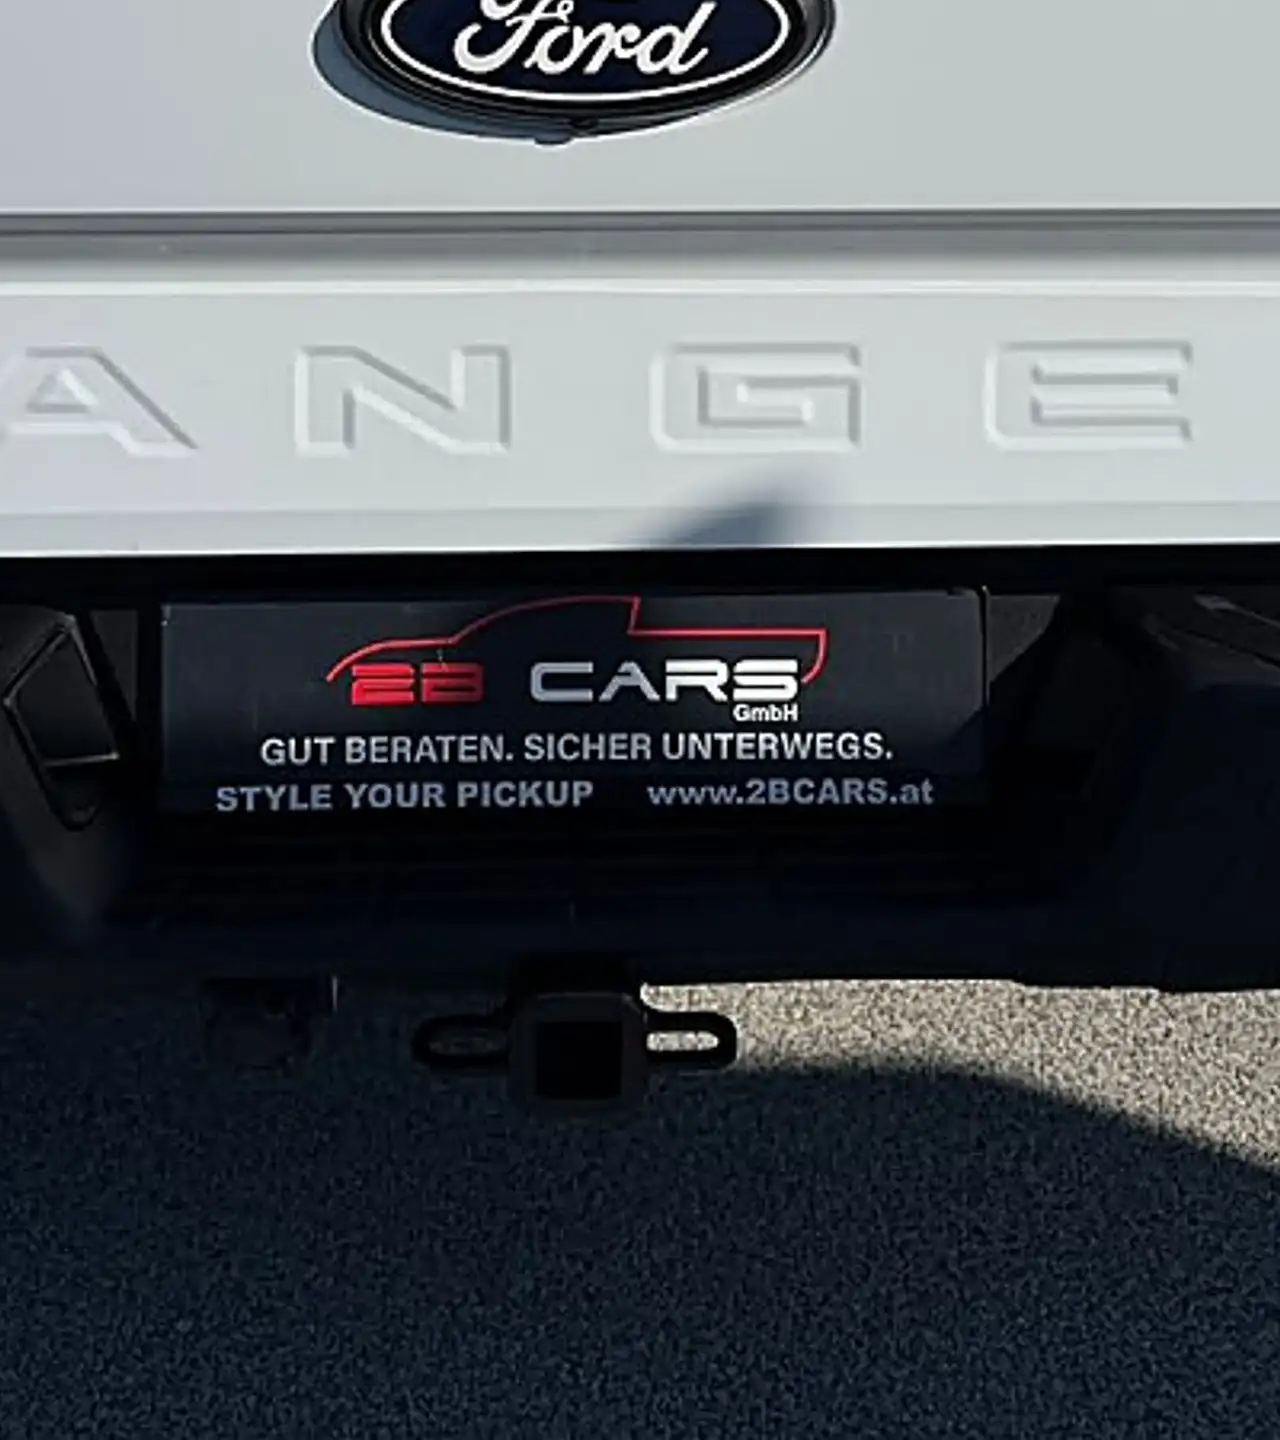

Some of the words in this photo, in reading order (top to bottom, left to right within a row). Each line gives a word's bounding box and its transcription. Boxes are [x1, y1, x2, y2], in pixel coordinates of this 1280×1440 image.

[351, 661, 483, 706] 2B
[530, 658, 800, 703] CARS
[732, 702, 800, 723] GmbH
[260, 736, 338, 765] GUT
[345, 734, 515, 764] BERATEN.
[523, 733, 652, 762] SICHER
[662, 731, 894, 762] UNTERWEGS.
[215, 783, 332, 812] STYLE
[343, 782, 446, 810] YOUR
[456, 779, 595, 808] PICKUP
[646, 777, 936, 808] www.2BCARS.at
